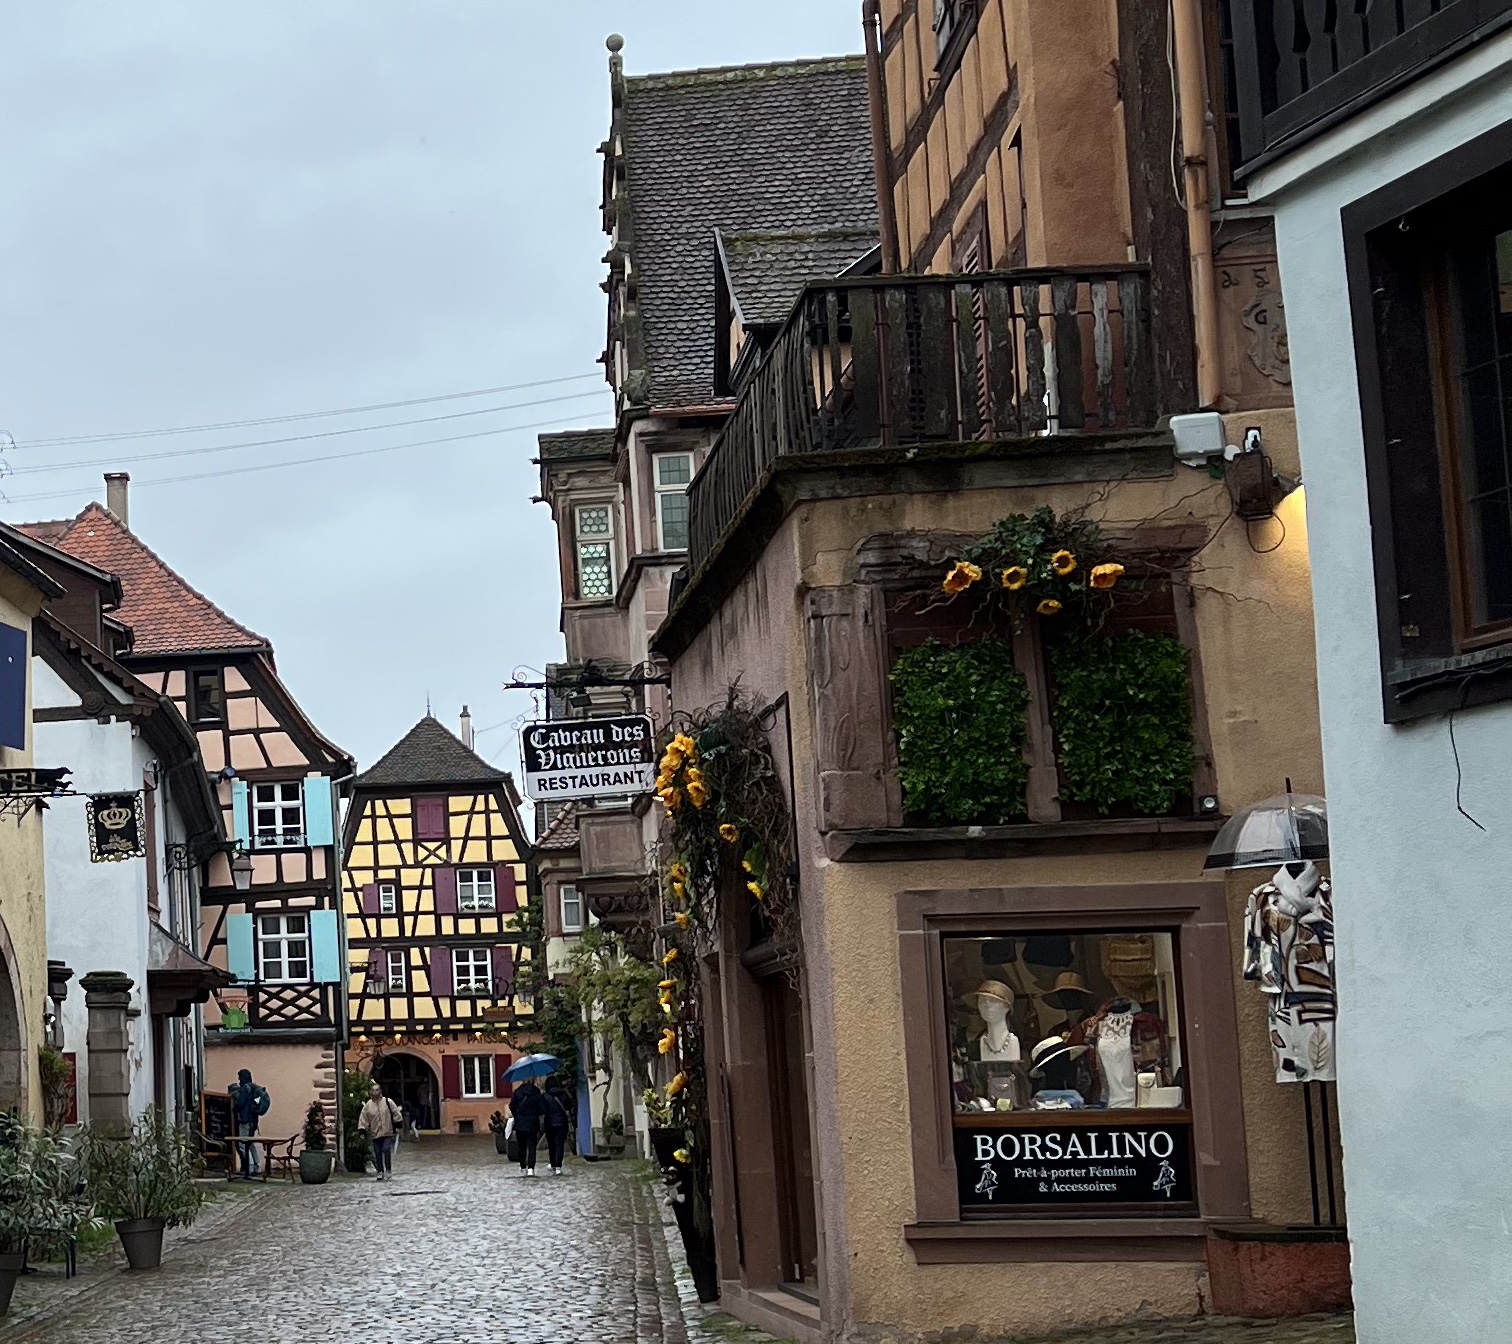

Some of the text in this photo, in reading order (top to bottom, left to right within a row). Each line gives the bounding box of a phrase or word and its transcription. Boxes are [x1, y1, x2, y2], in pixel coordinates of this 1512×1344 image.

[530, 723, 645, 749] Caveau des
[536, 747, 642, 770] Vignerons
[537, 770, 645, 792] RESTAURANT
[972, 1130, 1175, 1161] BORSALINO
[1014, 1165, 1137, 1181] Prêt-à-porter Féminin
[1038, 1181, 1118, 1192] & Accessoires
